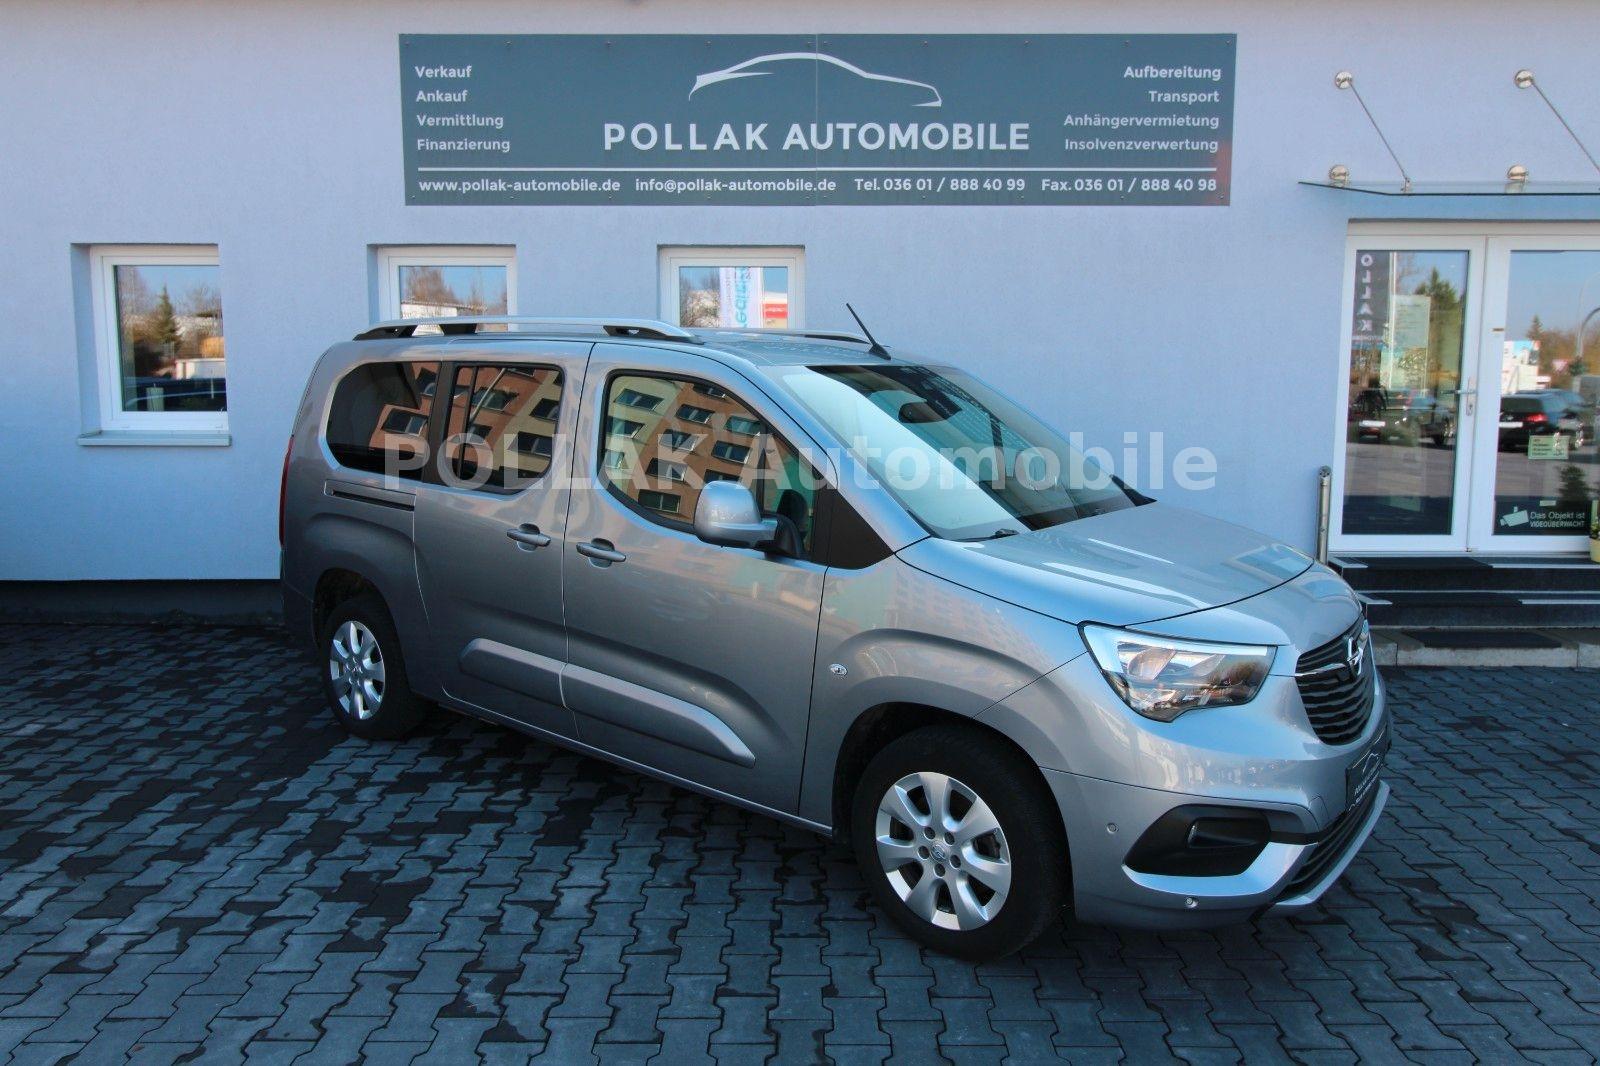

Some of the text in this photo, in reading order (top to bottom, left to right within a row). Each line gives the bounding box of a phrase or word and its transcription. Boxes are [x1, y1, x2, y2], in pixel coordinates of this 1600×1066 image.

[415, 66, 473, 79] Verkauf
[1124, 66, 1221, 81] Aufbereitung
[416, 90, 467, 102] Ankauf
[1149, 91, 1219, 104] Transport
[417, 114, 503, 128] Vermittlung
[1064, 114, 1219, 129] Anhängervermietung
[605, 123, 1029, 150] POLLAK AUTOMOBILE
[418, 138, 510, 152] Finanzierung
[1065, 138, 1218, 153] Insolvenzverwertung
[419, 179, 620, 193] www.pollak-automobile.de
[636, 179, 836, 193] info@pollak-automobile.de
[854, 177, 1025, 192] Tel. 036 01 / 888 40 99
[1042, 178, 1216, 192] Fax. 036 01 / 888 40 98
[1548, 512, 1574, 520] Objekt
